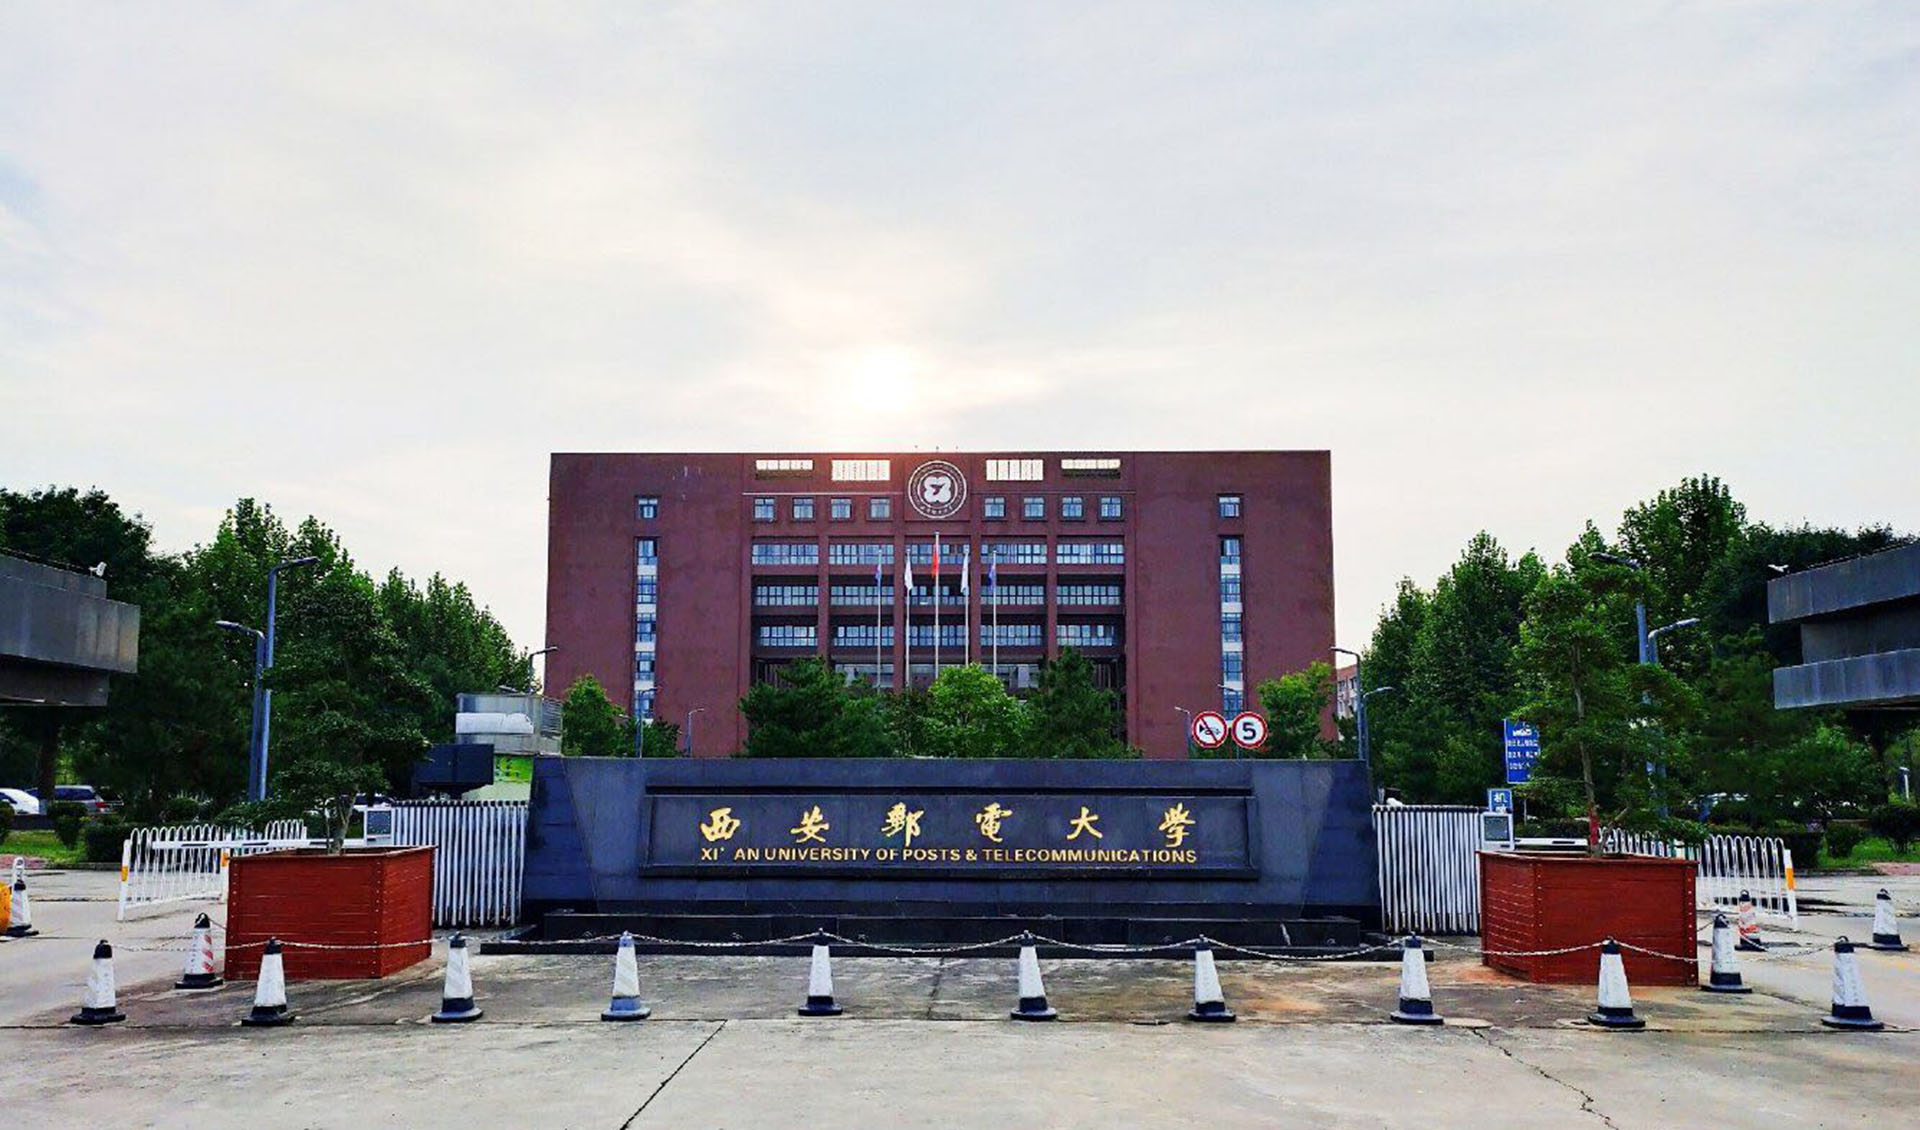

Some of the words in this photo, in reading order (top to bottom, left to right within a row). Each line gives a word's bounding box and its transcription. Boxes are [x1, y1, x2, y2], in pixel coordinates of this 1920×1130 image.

[1242, 722, 1256, 741] 5
[764, 848, 870, 861] UNIVERSITY
[875, 848, 899, 861] OF
[902, 848, 961, 861] POSTS
[965, 849, 978, 861] &
[982, 848, 1197, 863] TELECOMMUNICATIONS
